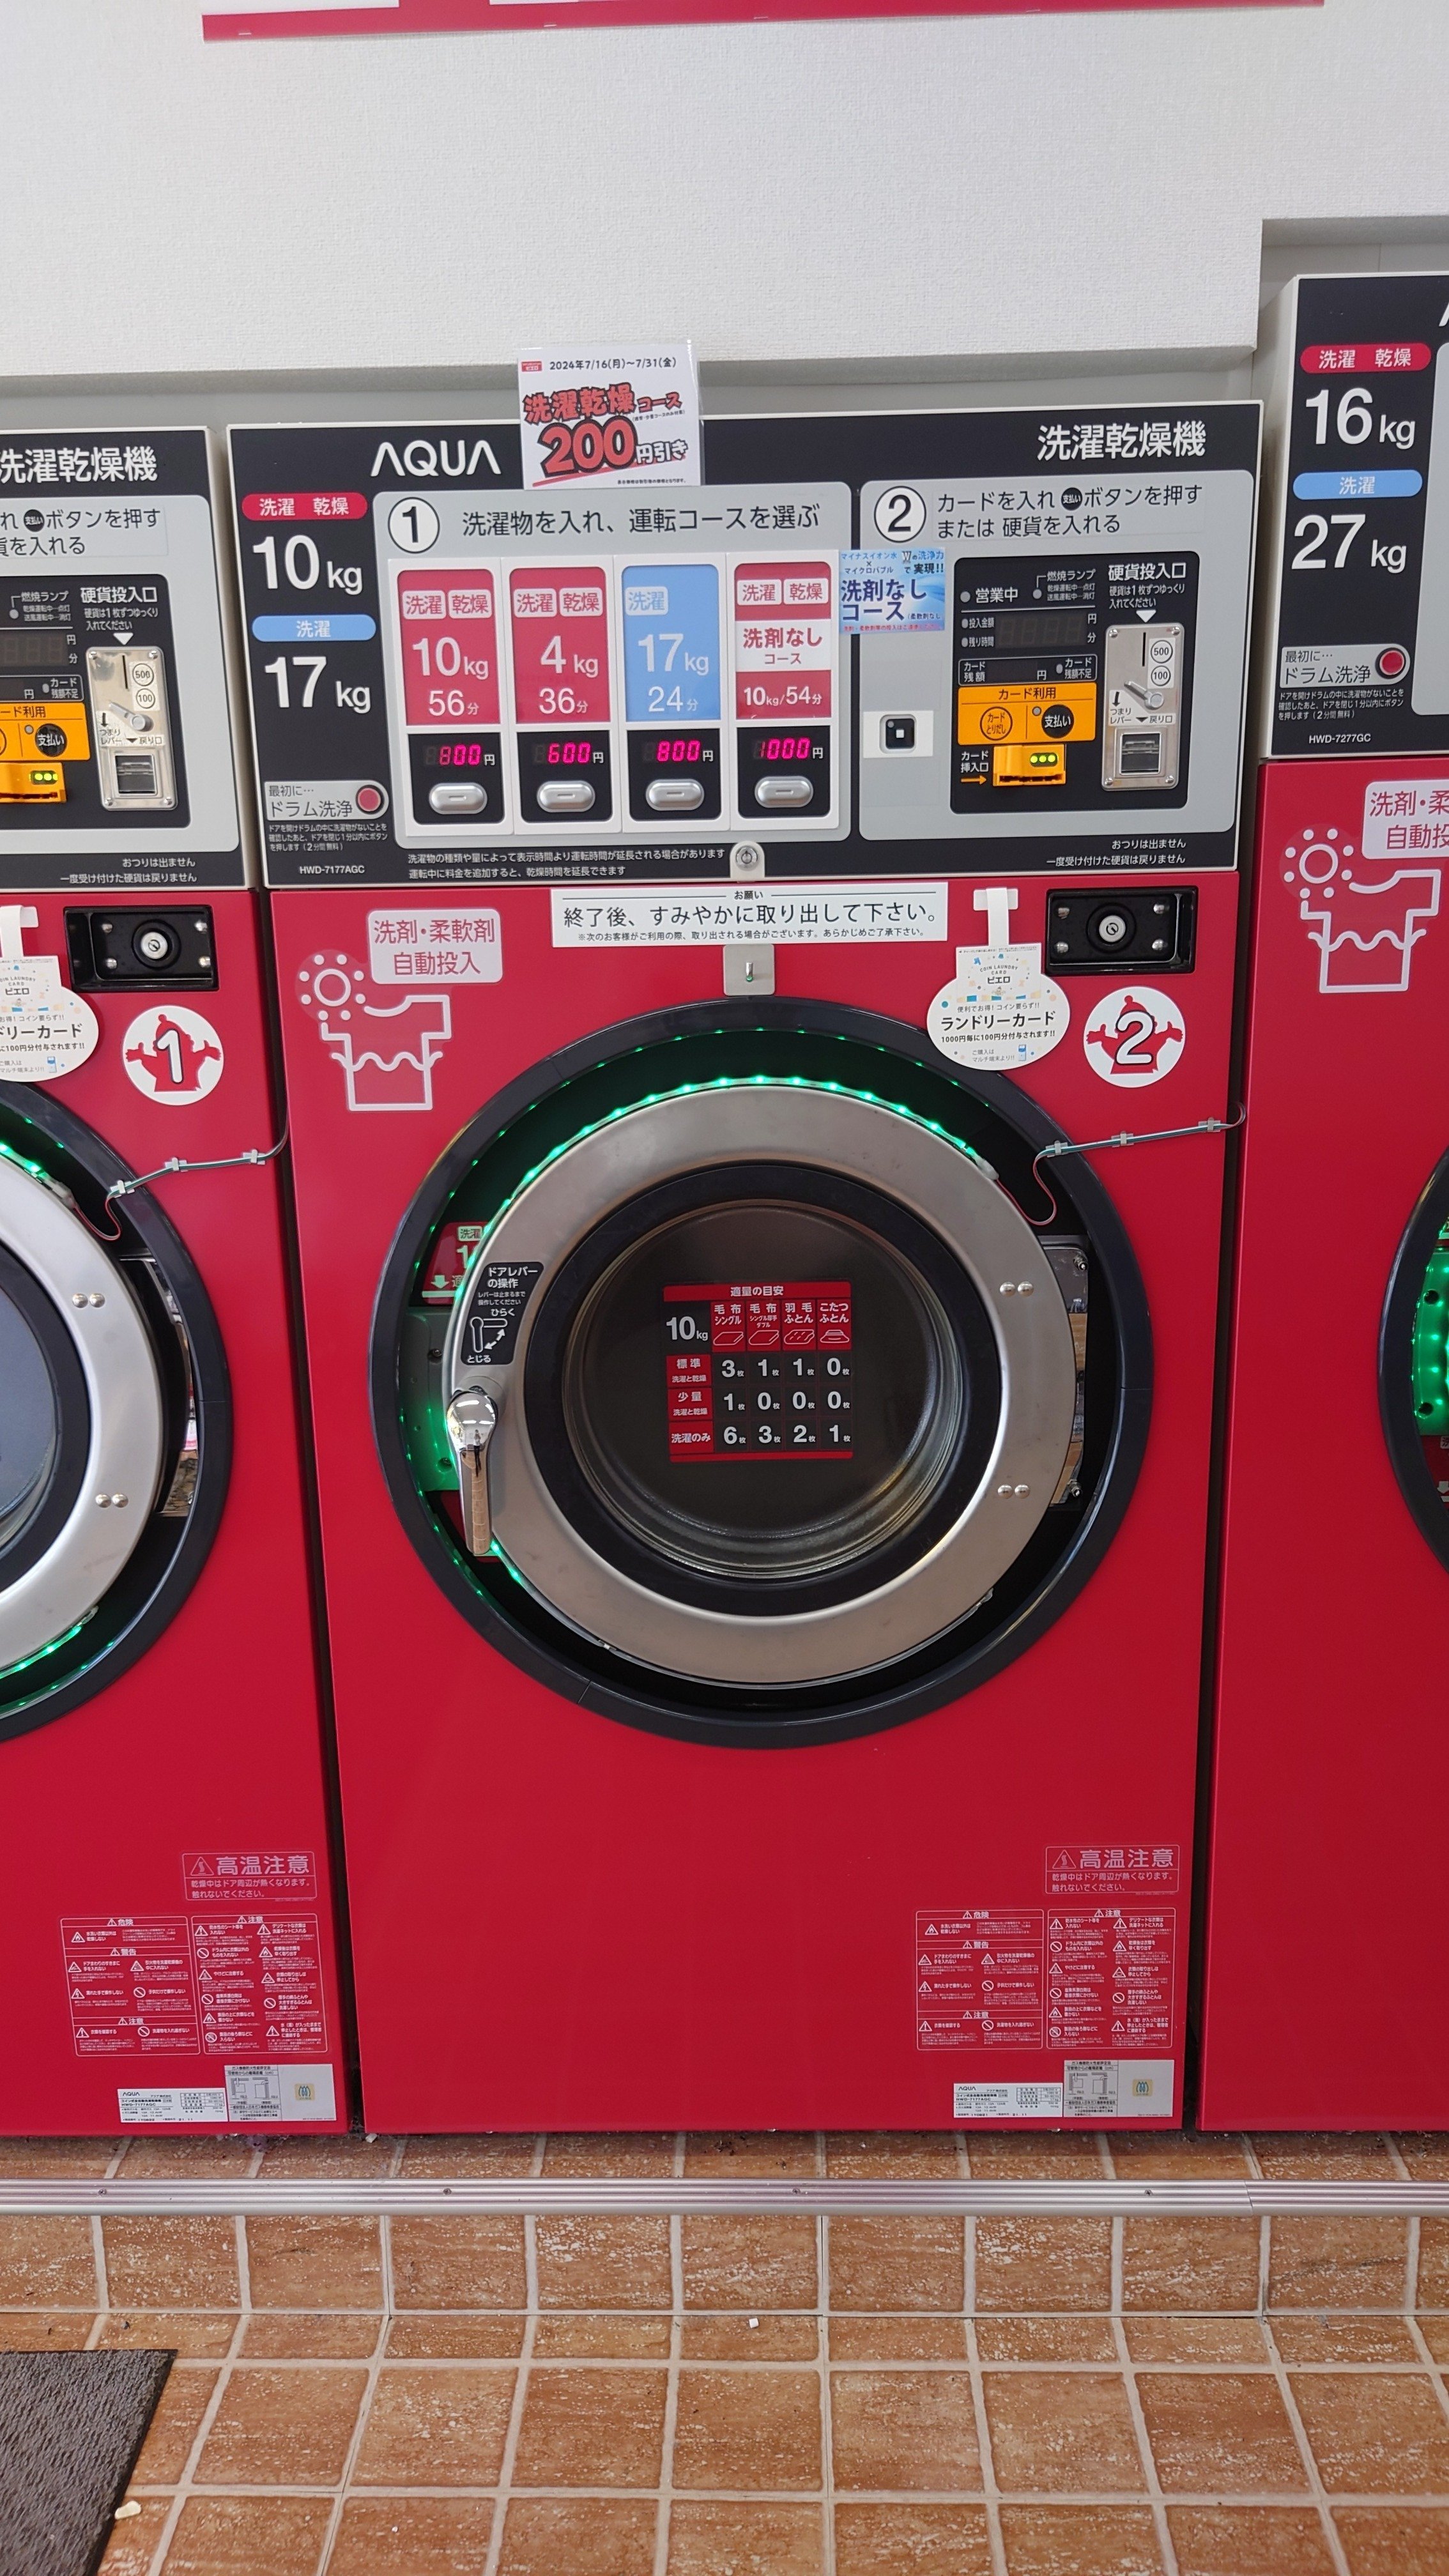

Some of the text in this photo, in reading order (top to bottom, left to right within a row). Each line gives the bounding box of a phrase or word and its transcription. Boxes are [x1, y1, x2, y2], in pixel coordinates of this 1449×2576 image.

[1319, 348, 1411, 369] 洗濯 乾燥
[1037, 420, 1206, 462] 洗濯乾燥機
[0, 446, 158, 484] 洗濯乾燥機
[371, 440, 502, 477] AQUA
[1339, 476, 1375, 495] 洗濯
[259, 498, 349, 516] 洗濯 乾燥
[463, 504, 821, 537] 洗濯物を入れ、運転コースを選ぶ
[1047, 569, 1096, 582] 燃焼ランプ
[1108, 562, 1186, 582] 硬貨投入口
[21, 590, 69, 603] 燃焼ランプ
[80, 587, 158, 604] 硬貨投入口
[743, 581, 824, 601] 洗濯 乾燥
[841, 579, 927, 602] 洗剤なし
[976, 586, 1019, 604] 営業中
[406, 594, 489, 615] 洗濯 乾燥
[517, 591, 601, 615] 洗濯 乾燥
[628, 590, 666, 612] 洗濯
[1109, 599, 1157, 610] 入れてください
[842, 601, 905, 622] コース
[86, 621, 133, 631] 入れてください
[969, 614, 1096, 629] 投入金額 円
[296, 620, 331, 638] 洗濯
[742, 627, 824, 649] 洗剤なし
[969, 632, 1096, 647] 残り時間 分
[765, 652, 802, 666] コース
[1153, 647, 1169, 657] 500
[963, 657, 1092, 672] カード カード
[135, 670, 151, 680] 500
[964, 668, 1092, 683] 残額 円 残額不足
[1152, 671, 1169, 681] 100
[1285, 665, 1371, 685] ドラム洗浄
[50, 678, 77, 688] カード
[138, 694, 153, 703] 100
[998, 686, 1057, 700] カード利用
[987, 713, 1006, 723] カード
[1109, 707, 1131, 716] つまり
[986, 715, 1071, 735] とりだし 支払い
[1110, 714, 1173, 724] レバー 戻り口
[37, 733, 65, 746] 支払い
[100, 728, 121, 737] つまり
[1308, 733, 1372, 744] HWD-7277GC
[100, 736, 163, 746] レバー 戻り口
[961, 751, 990, 762] カード
[960, 762, 990, 773] 挿入口
[270, 800, 353, 818] ドラム洗浄
[1112, 838, 1186, 850] おつりは出ません
[122, 857, 196, 868] おつりは出ません
[1046, 854, 1186, 868] 一度受け付けた硬貨は戻りません
[300, 865, 365, 875] HWD-7177AGC
[60, 871, 197, 884] 一度受け付けた硬貨は戻りません
[733, 889, 764, 901] お願い
[563, 901, 937, 929] 終了後、すみやかに取り出して下さい。
[374, 919, 495, 945] 洗剤・柔軟剤
[394, 951, 481, 976] 自動投入
[987, 976, 1011, 985] ピエロ
[5, 987, 30, 996] ピエロ
[940, 1010, 1056, 1032] ランドリーカード
[1116, 1009, 1155, 1066] 2
[155, 1028, 184, 1084] 1
[488, 1266, 538, 1277] ドアレバー
[487, 1278, 519, 1289] の操作
[730, 1286, 784, 1297] 適量の目安
[491, 1308, 516, 1317] ひらく
[820, 1301, 849, 1312] こたつ
[714, 1314, 849, 1326] シングル ふとん ふとん
[466, 1355, 492, 1363] とじる
[671, 1433, 711, 1444] 洗濯のみ
[215, 1855, 310, 1876] 高温注意
[1080, 1848, 1174, 1869] 高温注意
